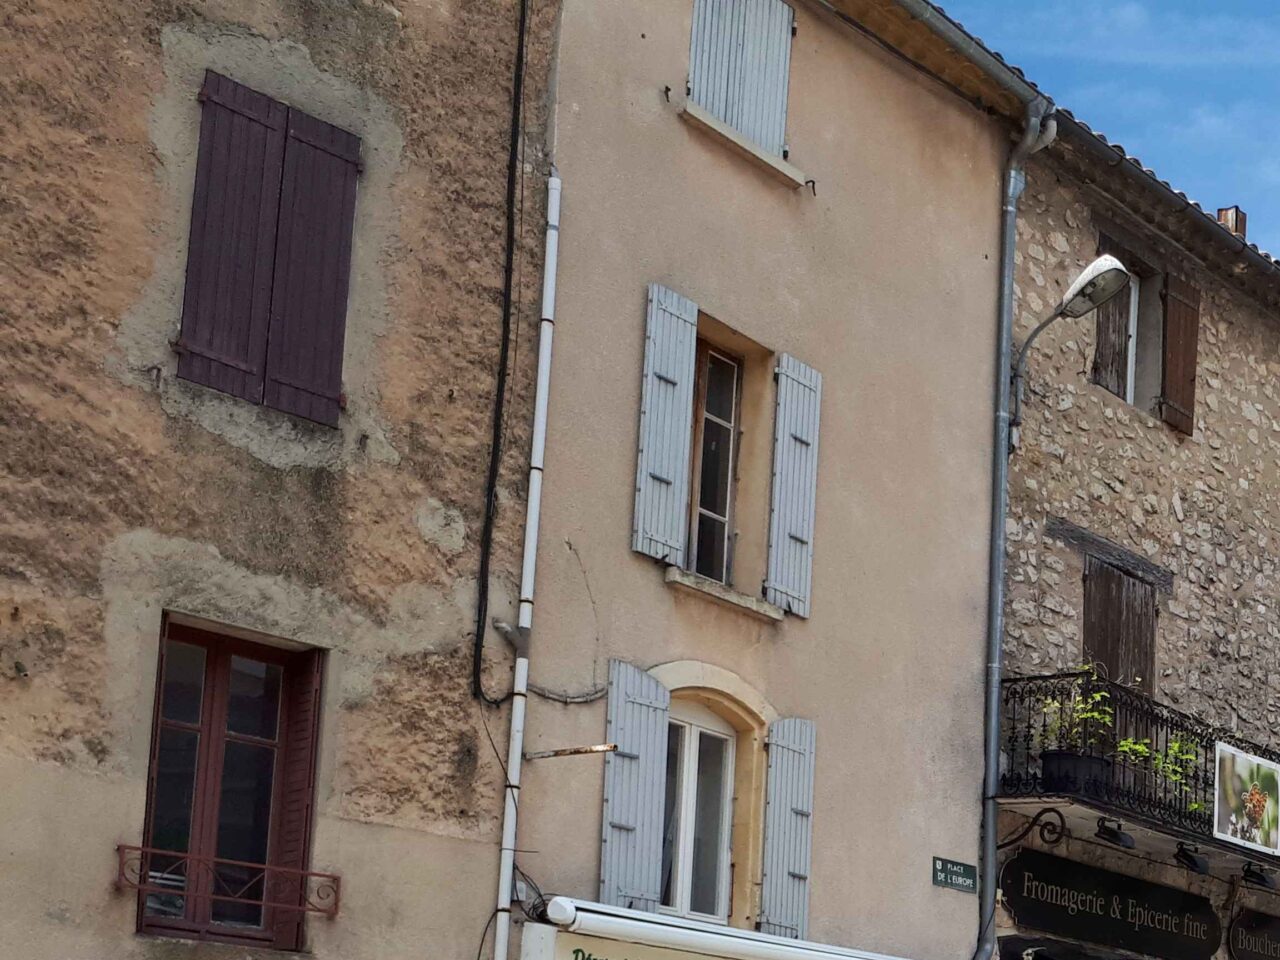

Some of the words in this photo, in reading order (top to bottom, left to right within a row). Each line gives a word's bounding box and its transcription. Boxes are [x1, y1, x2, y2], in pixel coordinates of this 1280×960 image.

[947, 863, 964, 873] PLACE
[937, 871, 946, 881] DE
[1022, 871, 1106, 916] Fromagerie
[1109, 896, 1122, 918] &
[1127, 898, 1180, 934] Epicerie
[1183, 912, 1208, 941] fine
